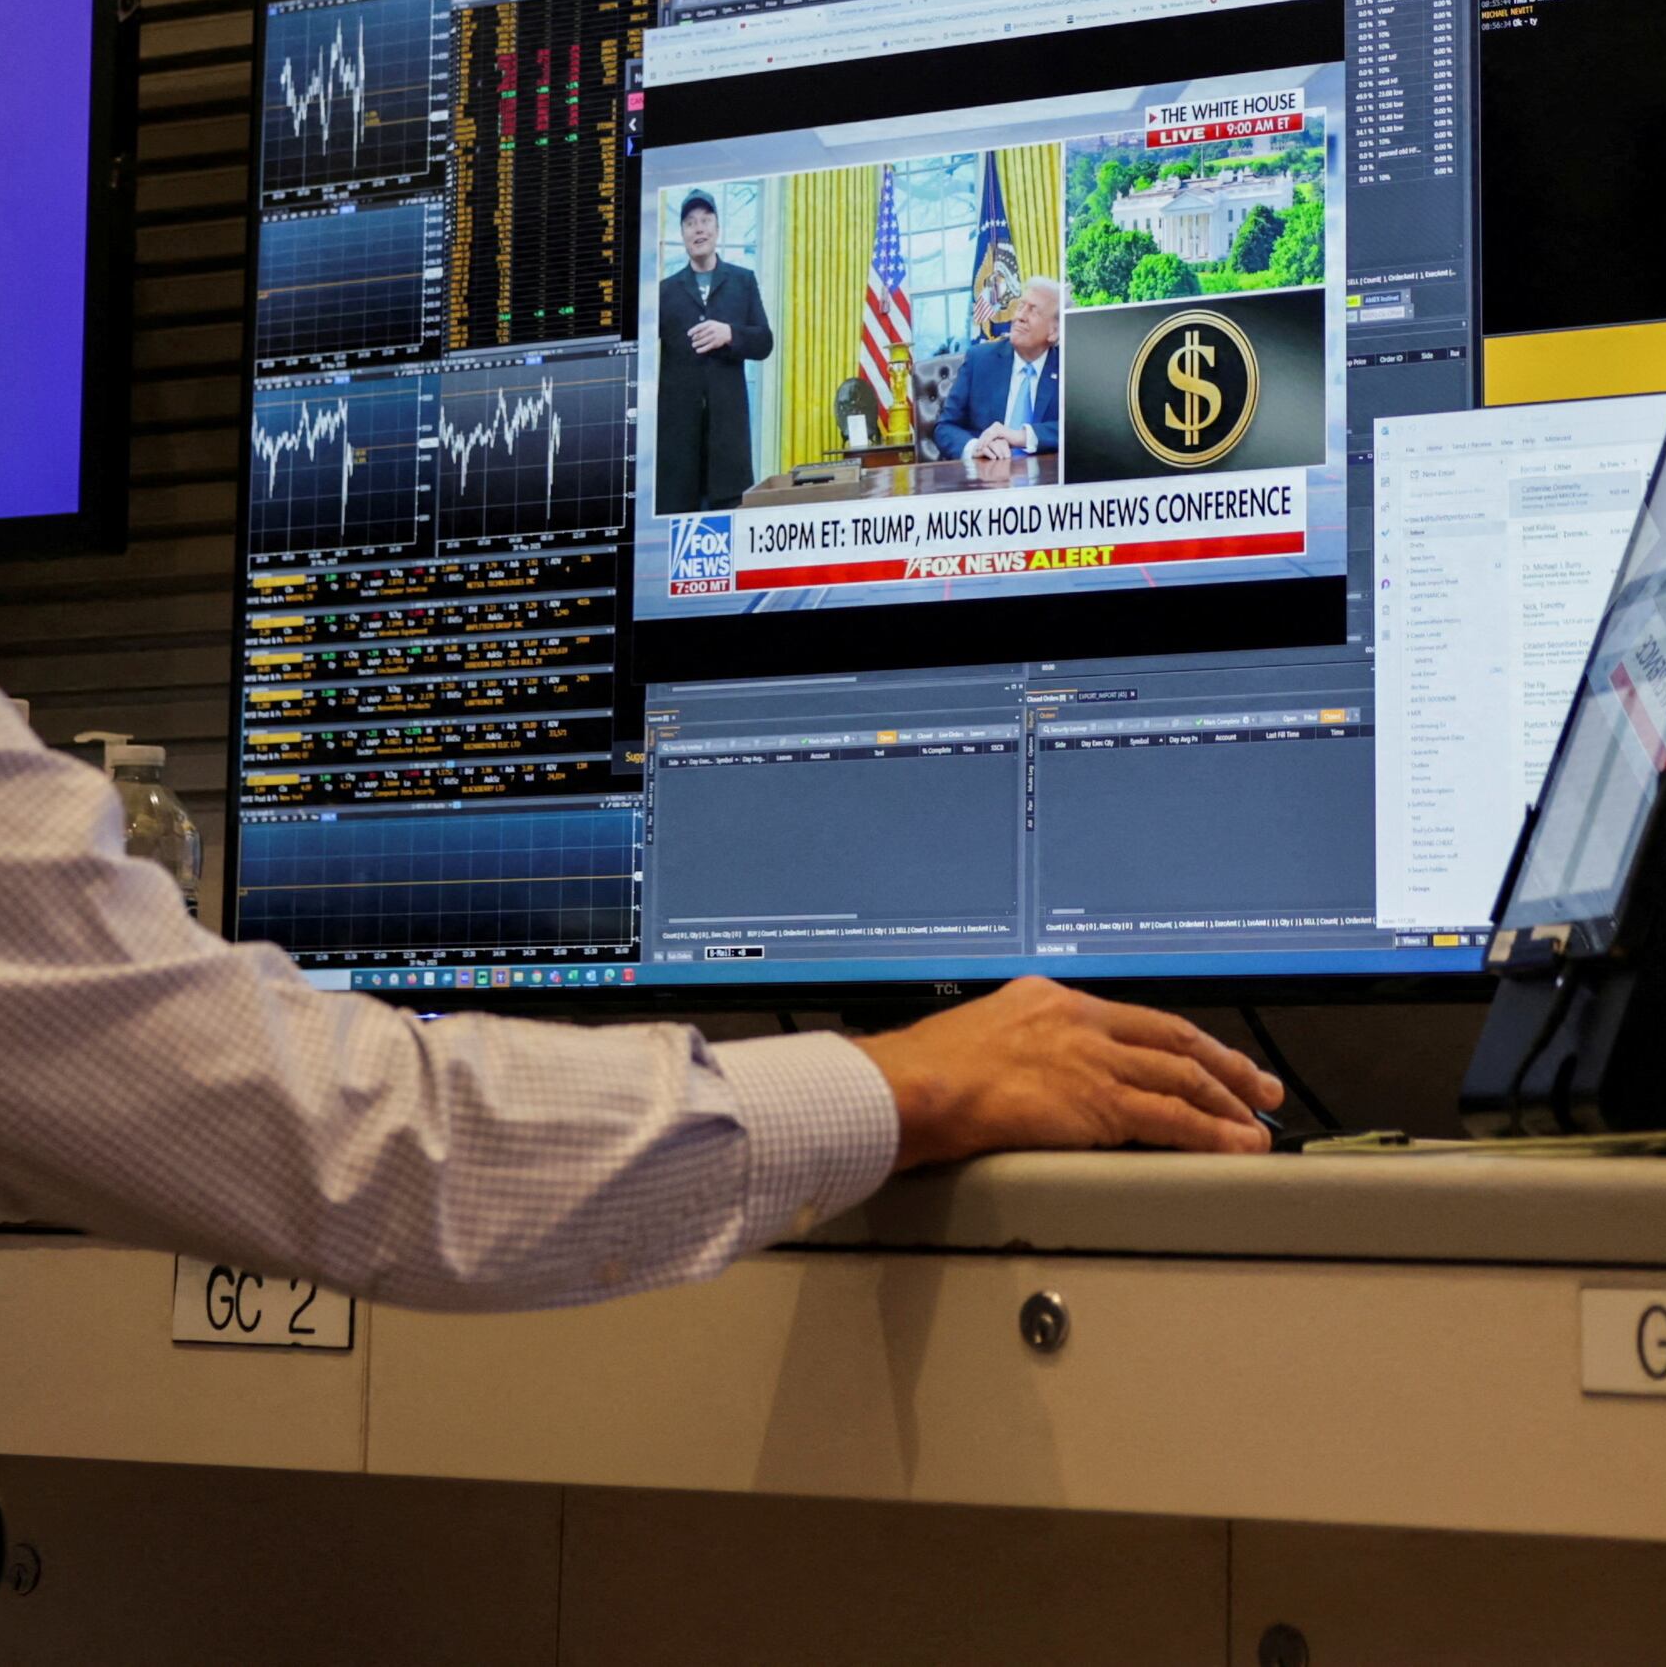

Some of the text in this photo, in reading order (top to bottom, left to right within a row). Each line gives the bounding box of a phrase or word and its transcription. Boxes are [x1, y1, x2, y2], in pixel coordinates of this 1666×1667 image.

[1161, 92, 1296, 124] THE WHITE HOUSE
[1158, 116, 1290, 144] LIVE 9:00 AM ET
[749, 486, 1291, 554] 1:30PM ET: TRUMP, MUSK HOLD WH NEWS CONFERENCE
[690, 533, 730, 556] FOX
[679, 556, 730, 578] NEWS
[919, 546, 1115, 577] FOX NEWS ALERT
[676, 579, 730, 594] 7:00 MT
[934, 983, 962, 995] TCL
[206, 1264, 317, 1335] GC 2
